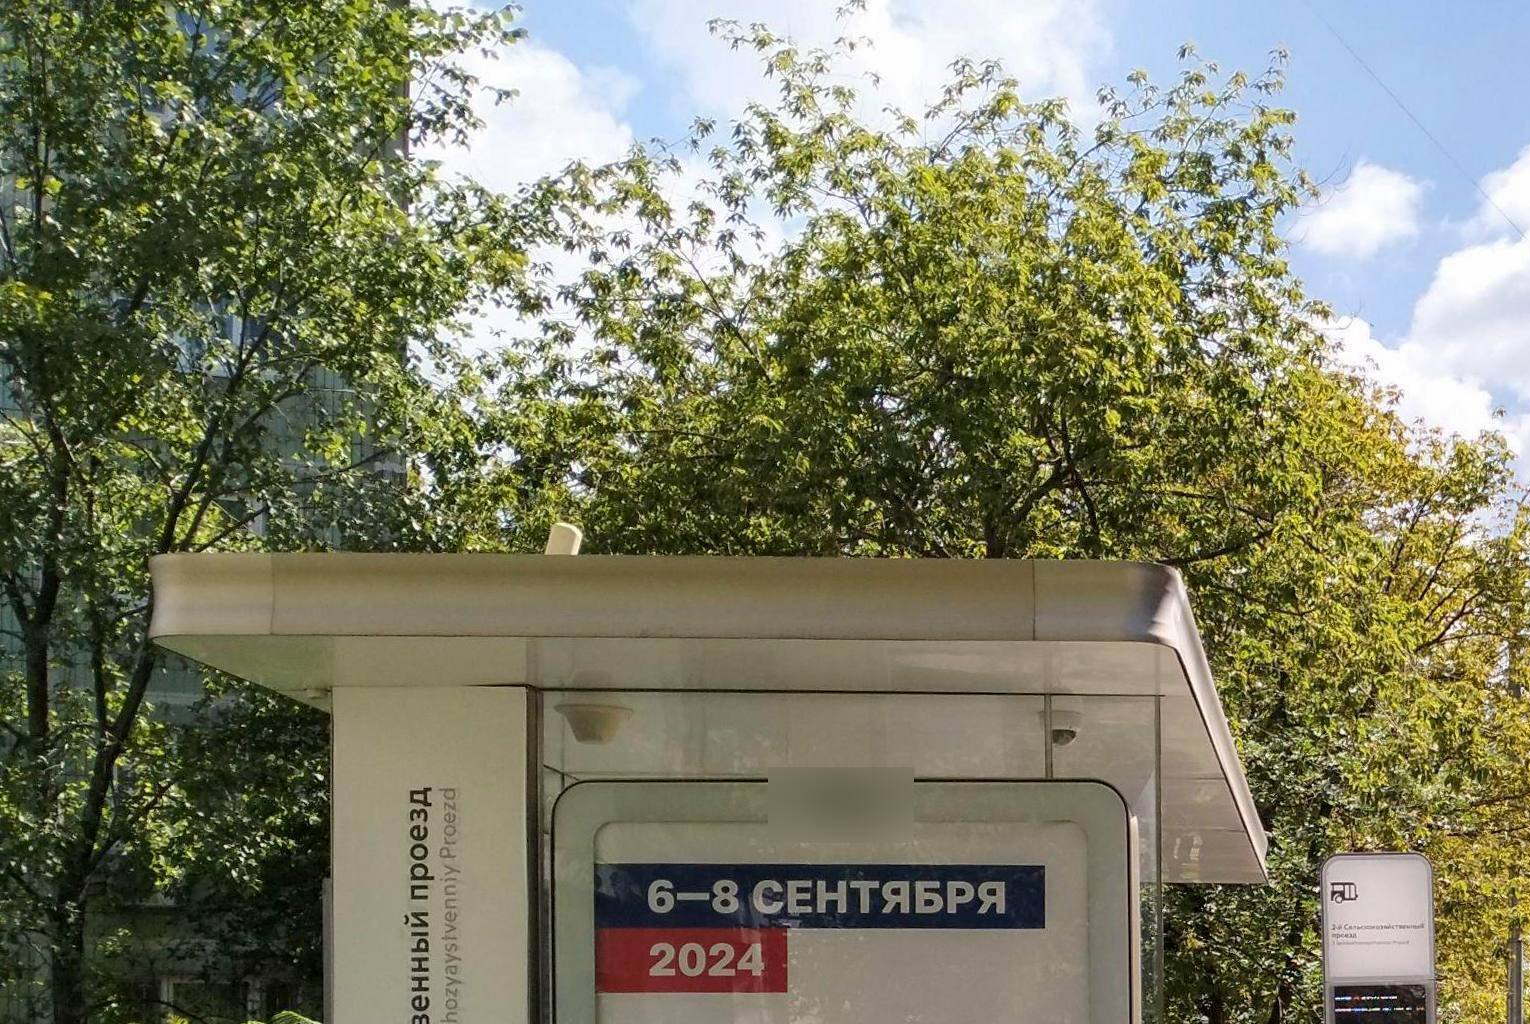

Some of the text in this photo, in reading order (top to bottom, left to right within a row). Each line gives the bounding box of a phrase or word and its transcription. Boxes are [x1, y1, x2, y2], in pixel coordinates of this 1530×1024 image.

[408, 786, 435, 901] проезд
[438, 786, 457, 859] Proezd
[752, 879, 1007, 916] СЕНТЯБРЯ
[648, 941, 766, 977] 2024
